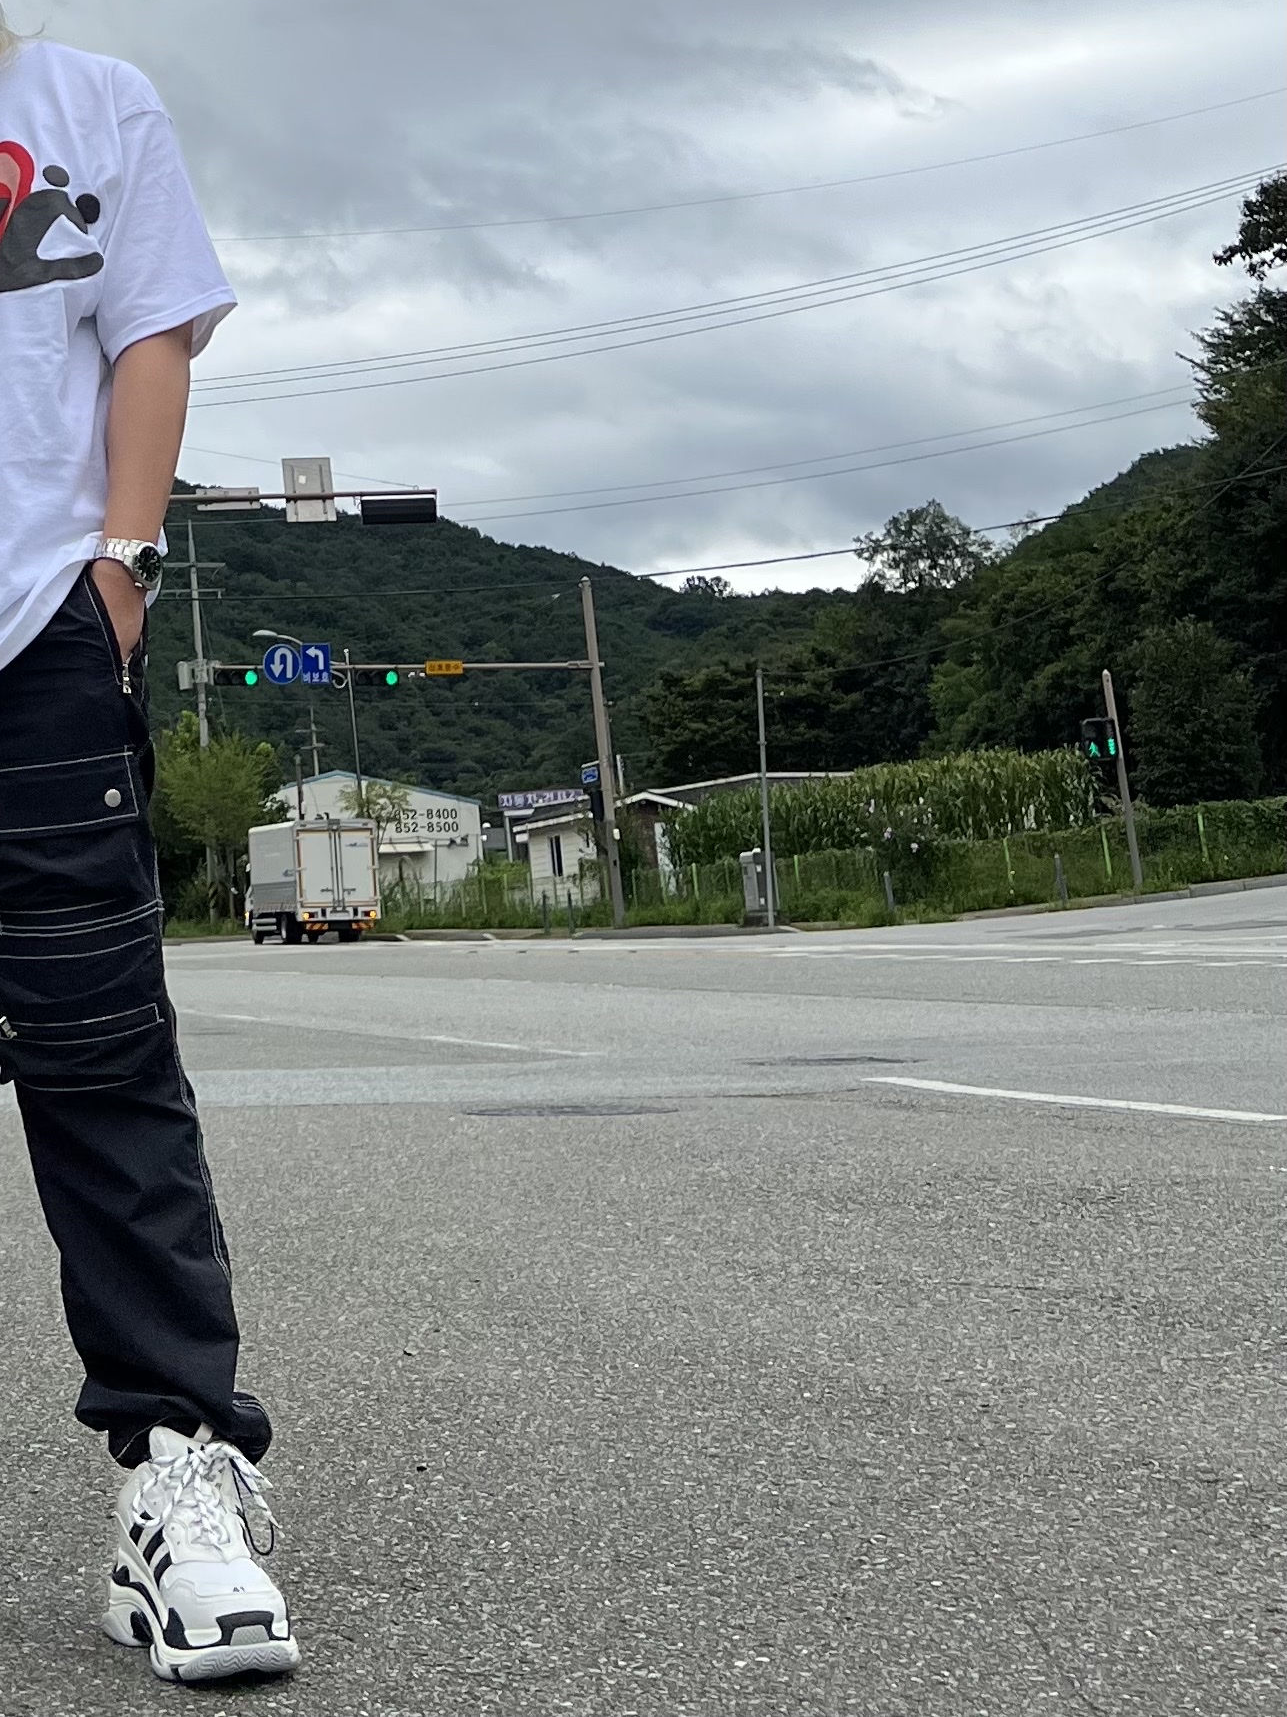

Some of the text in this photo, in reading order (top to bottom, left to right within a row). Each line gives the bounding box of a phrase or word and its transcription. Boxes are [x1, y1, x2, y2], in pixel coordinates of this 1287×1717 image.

[302, 670, 330, 684] 비보호
[394, 808, 458, 820] 852-8400
[395, 821, 459, 834] 852-8500
